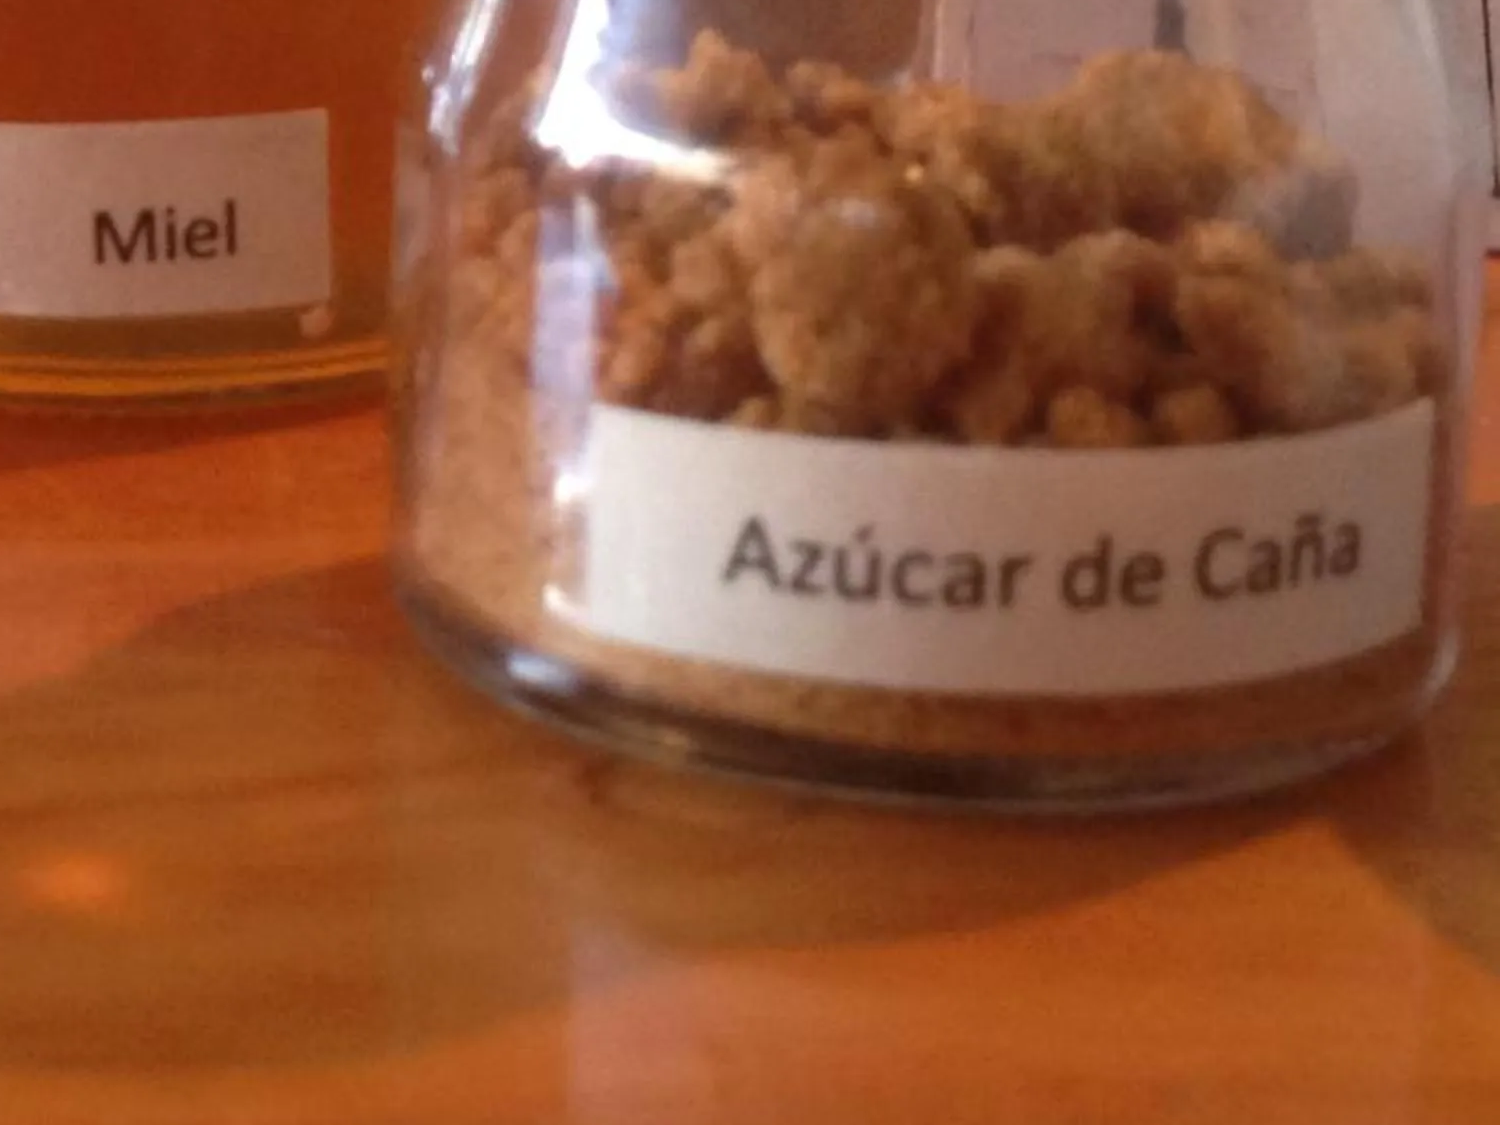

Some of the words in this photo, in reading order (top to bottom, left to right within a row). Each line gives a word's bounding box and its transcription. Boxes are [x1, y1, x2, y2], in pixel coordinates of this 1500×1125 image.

[93, 197, 238, 265] Miel
[721, 514, 1033, 611] Azúcar
[1058, 534, 1167, 610] de
[1193, 512, 1363, 601] Caña
